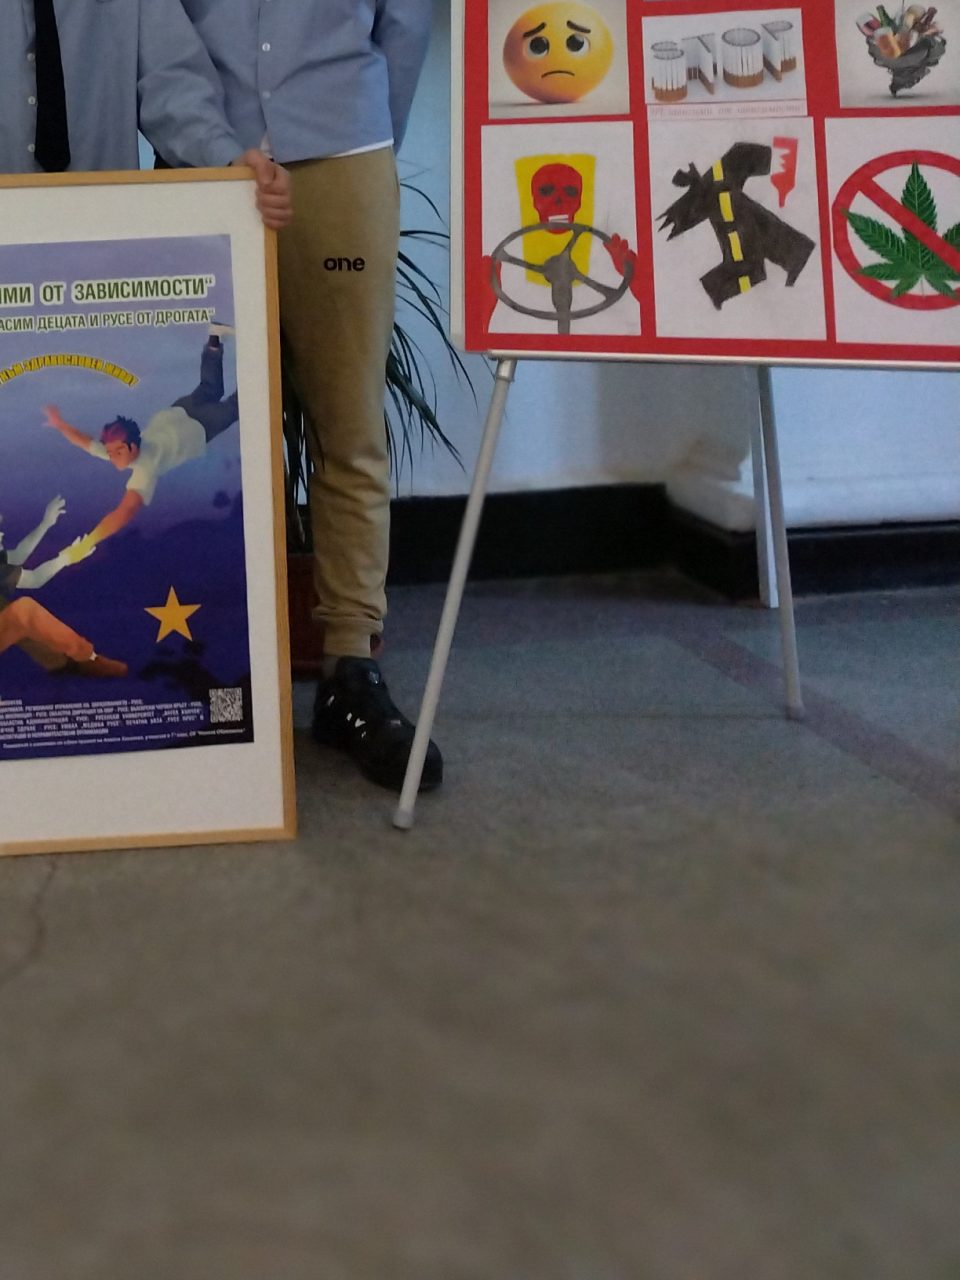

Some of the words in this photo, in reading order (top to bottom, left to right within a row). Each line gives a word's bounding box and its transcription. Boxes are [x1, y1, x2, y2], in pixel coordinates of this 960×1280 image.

[323, 257, 366, 271] one
[42, 284, 64, 303] ОТ
[75, 278, 212, 301] ЗАВИСИМОСТИ“
[37, 315, 86, 331] ДЕЦАТА
[89, 315, 99, 326] И
[101, 312, 133, 326] РУСЕ
[136, 312, 151, 324] ОТ
[155, 309, 214, 325] ДРОГАТА“
